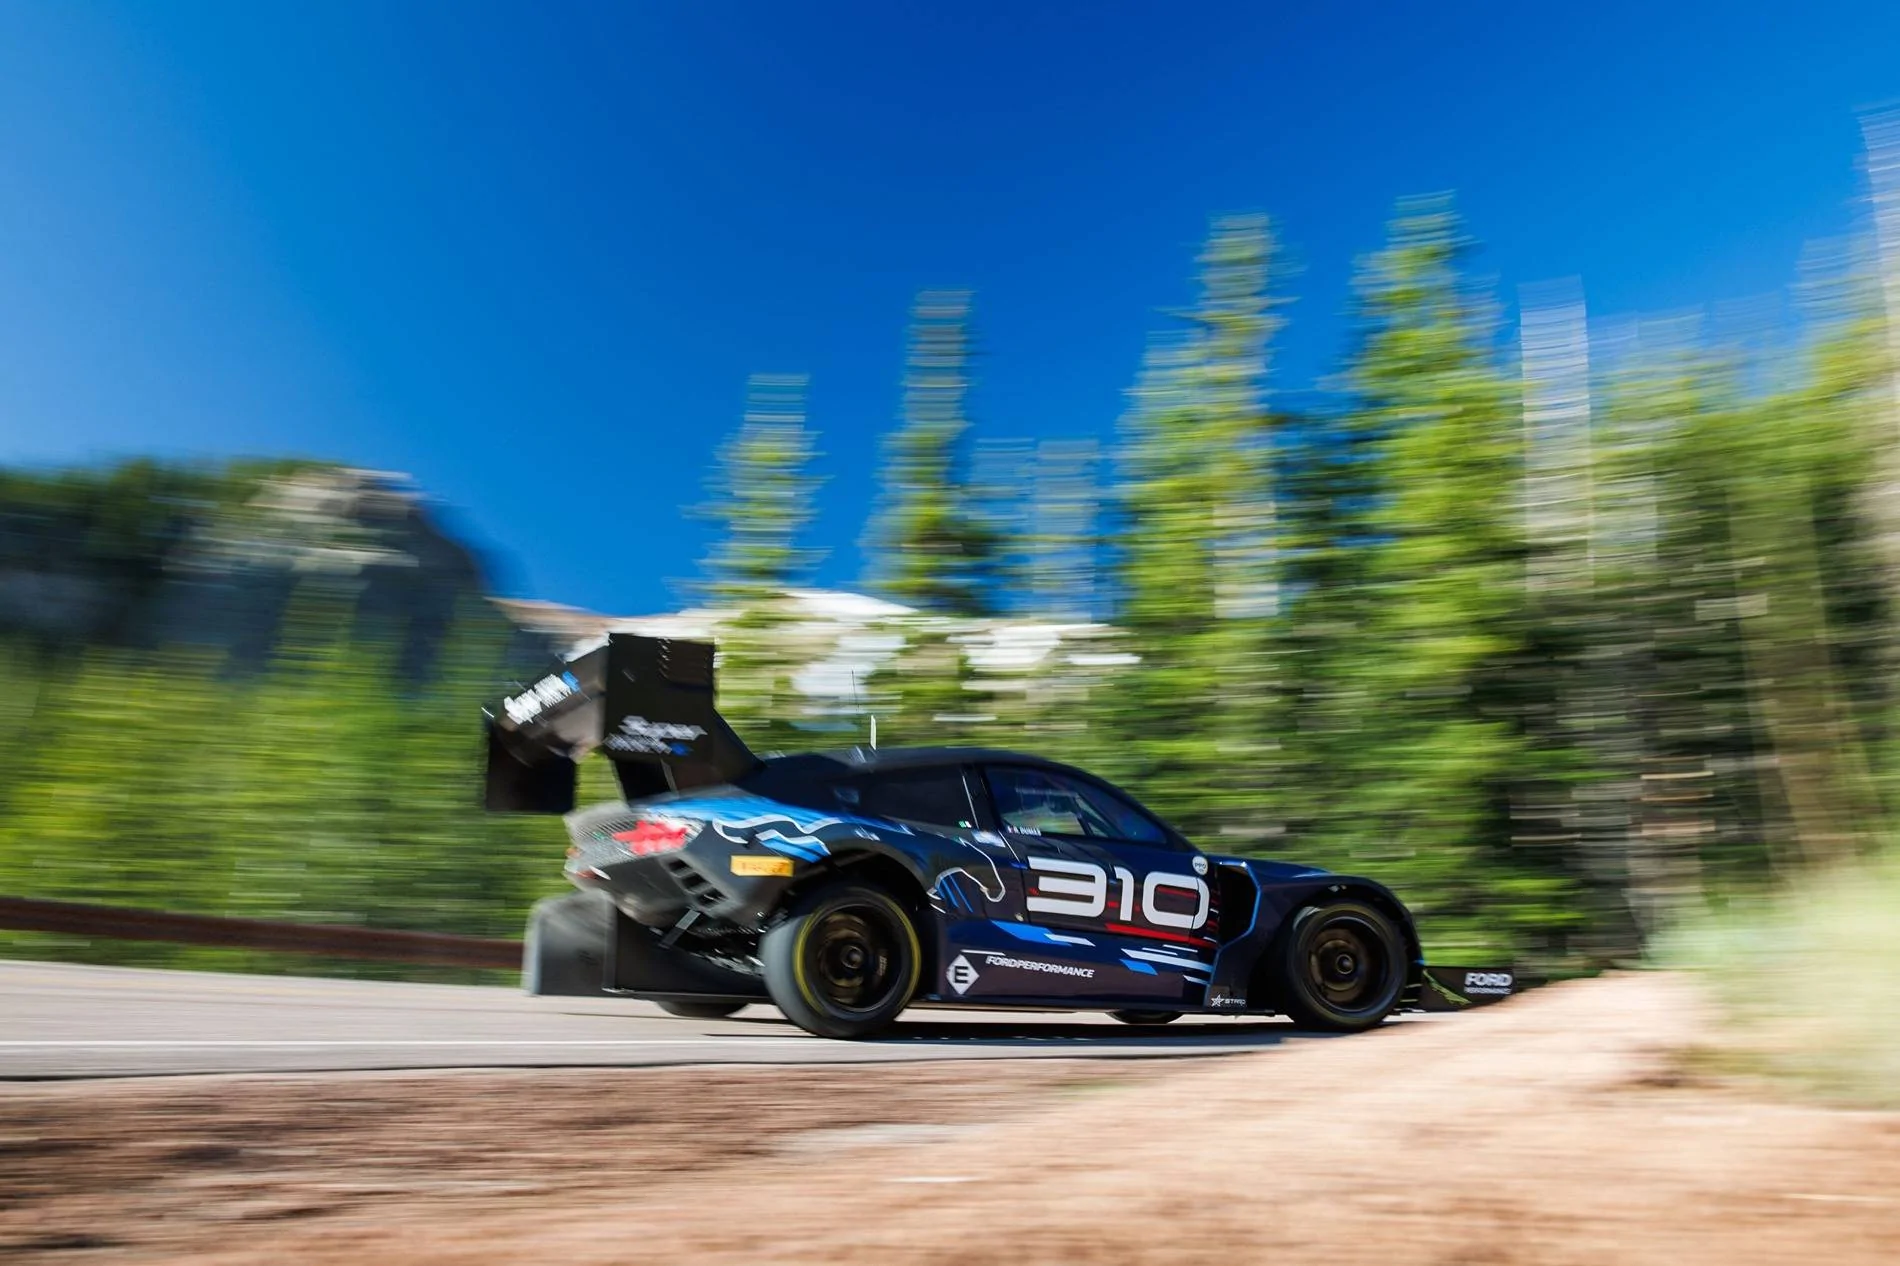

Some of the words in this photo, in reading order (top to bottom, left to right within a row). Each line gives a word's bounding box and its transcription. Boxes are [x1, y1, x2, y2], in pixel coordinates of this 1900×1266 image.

[1026, 856, 1210, 930] 310
[954, 965, 969, 983] E
[1464, 972, 1513, 987] FORD
